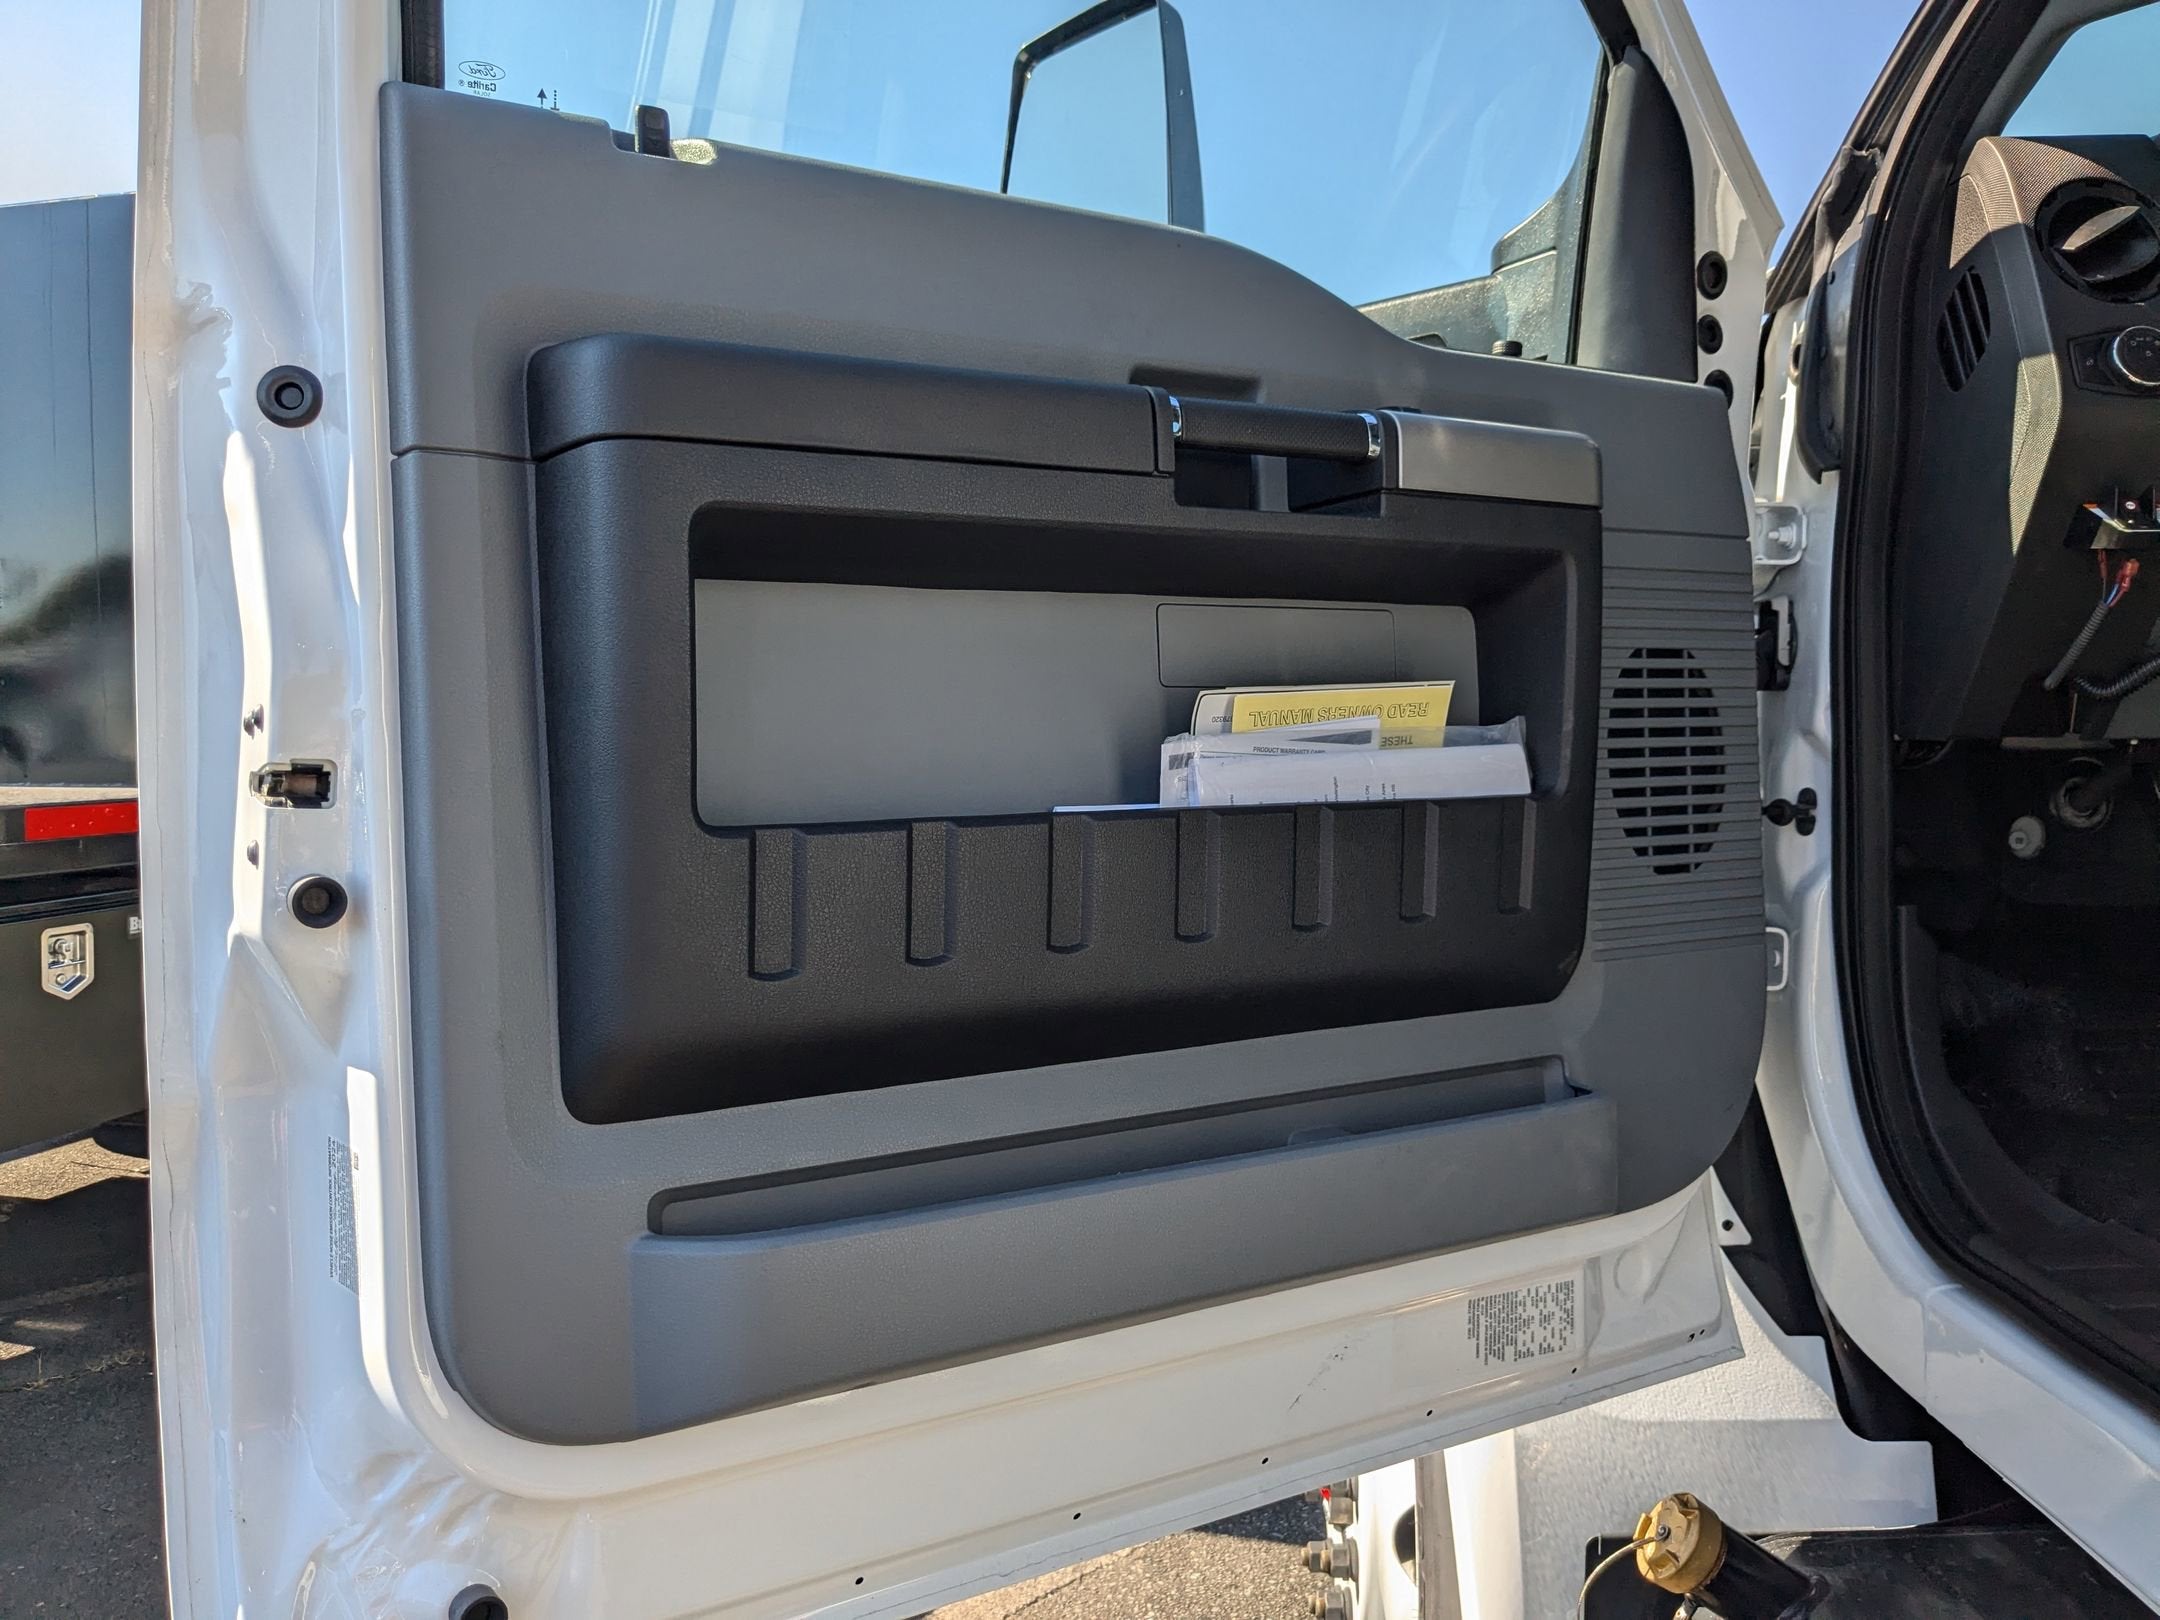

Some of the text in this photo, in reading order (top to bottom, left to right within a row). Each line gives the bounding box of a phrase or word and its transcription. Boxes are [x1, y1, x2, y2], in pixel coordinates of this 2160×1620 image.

[1387, 702, 1429, 719] READ
[1211, 715, 1233, 723] 79320
[1249, 707, 1315, 728] MANUAL
[1381, 735, 1413, 746] THESE
[1253, 746, 1280, 754] PRODUCT
